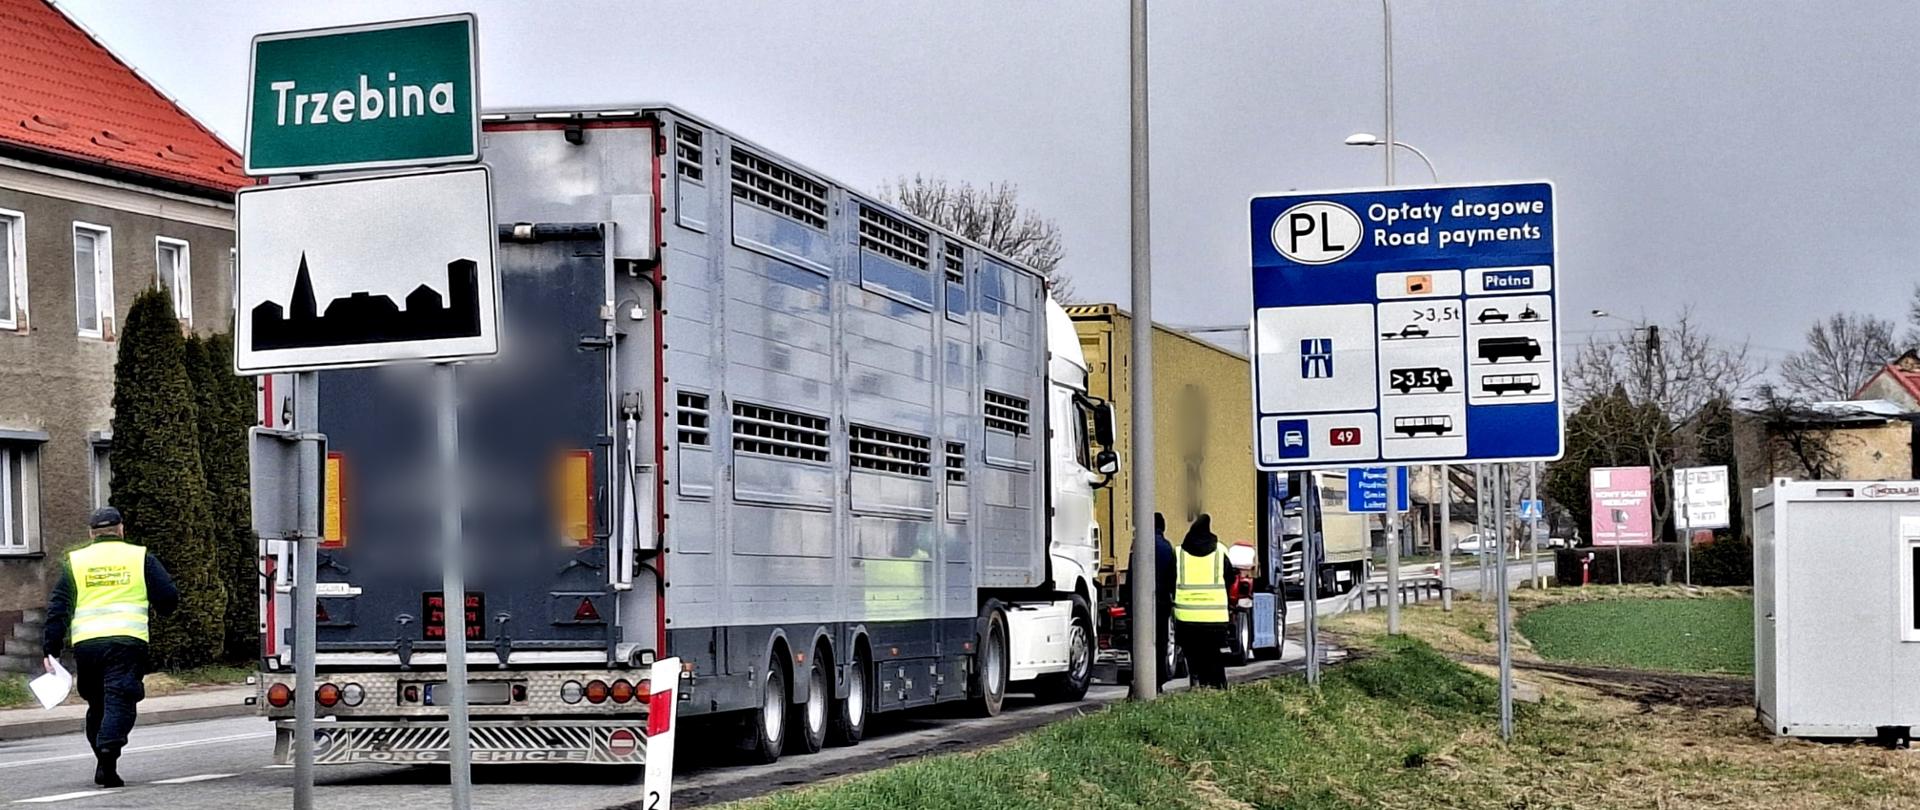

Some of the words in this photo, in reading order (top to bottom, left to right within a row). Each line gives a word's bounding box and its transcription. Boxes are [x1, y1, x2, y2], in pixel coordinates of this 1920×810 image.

[271, 72, 455, 126] Trzebina
[1368, 202, 1443, 226] Opłaty
[1451, 200, 1544, 221] drogowe
[1289, 211, 1345, 254] PL
[1374, 227, 1429, 247] Road
[1439, 223, 1541, 249] payments
[1485, 274, 1531, 288] Płatna
[1413, 307, 1460, 323] >3,5t
[1392, 370, 1440, 387] >3,5t
[1337, 431, 1354, 443] 49
[351, 750, 440, 761] LONG
[470, 750, 587, 762] EHICLE
[648, 790, 661, 810] 2
